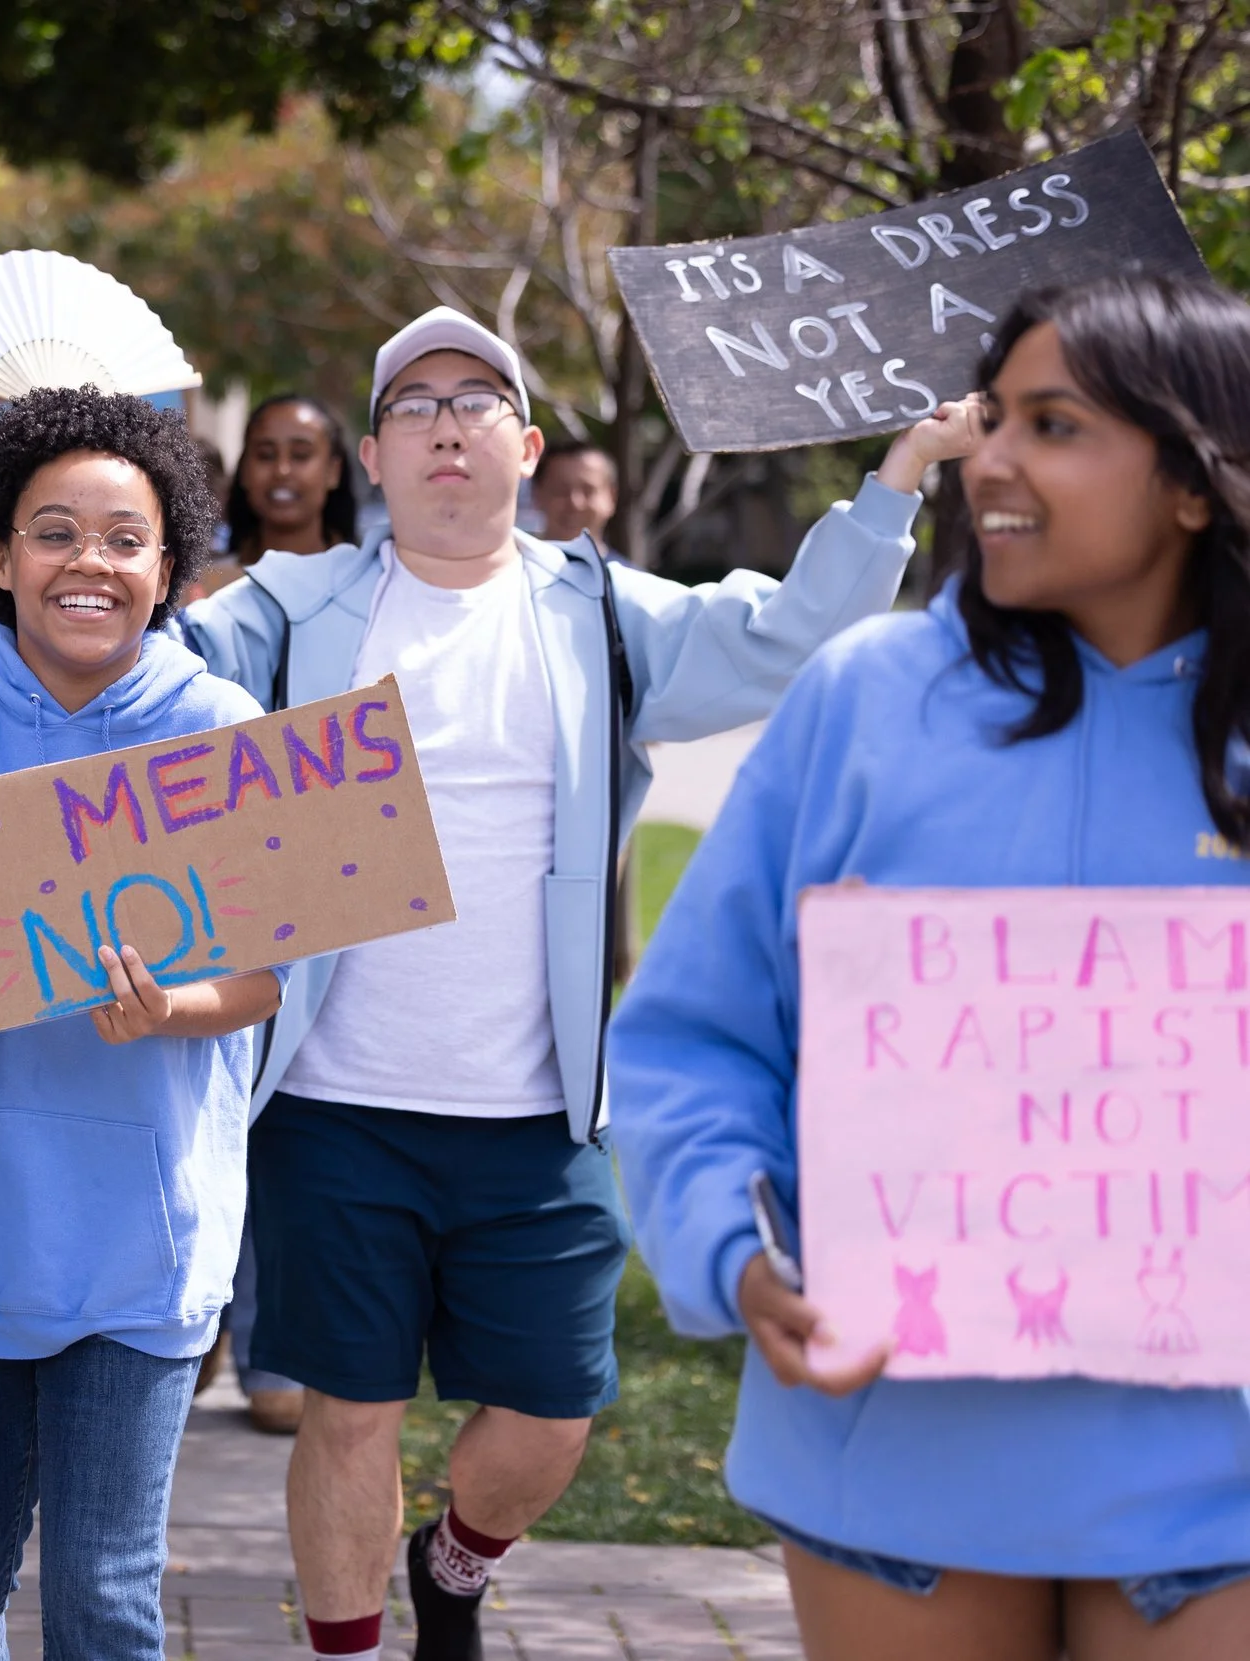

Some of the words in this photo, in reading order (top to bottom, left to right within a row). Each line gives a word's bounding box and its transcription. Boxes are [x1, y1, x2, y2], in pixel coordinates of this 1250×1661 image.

[664, 245, 763, 301] IT'S
[782, 244, 845, 294] A
[871, 173, 1089, 271] DRESS
[705, 301, 882, 378] NOT
[930, 282, 997, 335] A
[795, 358, 938, 429] YES
[53, 700, 404, 864] MEANS
[20, 863, 227, 1004] NO!
[1017, 1089, 1200, 1146] NOT
